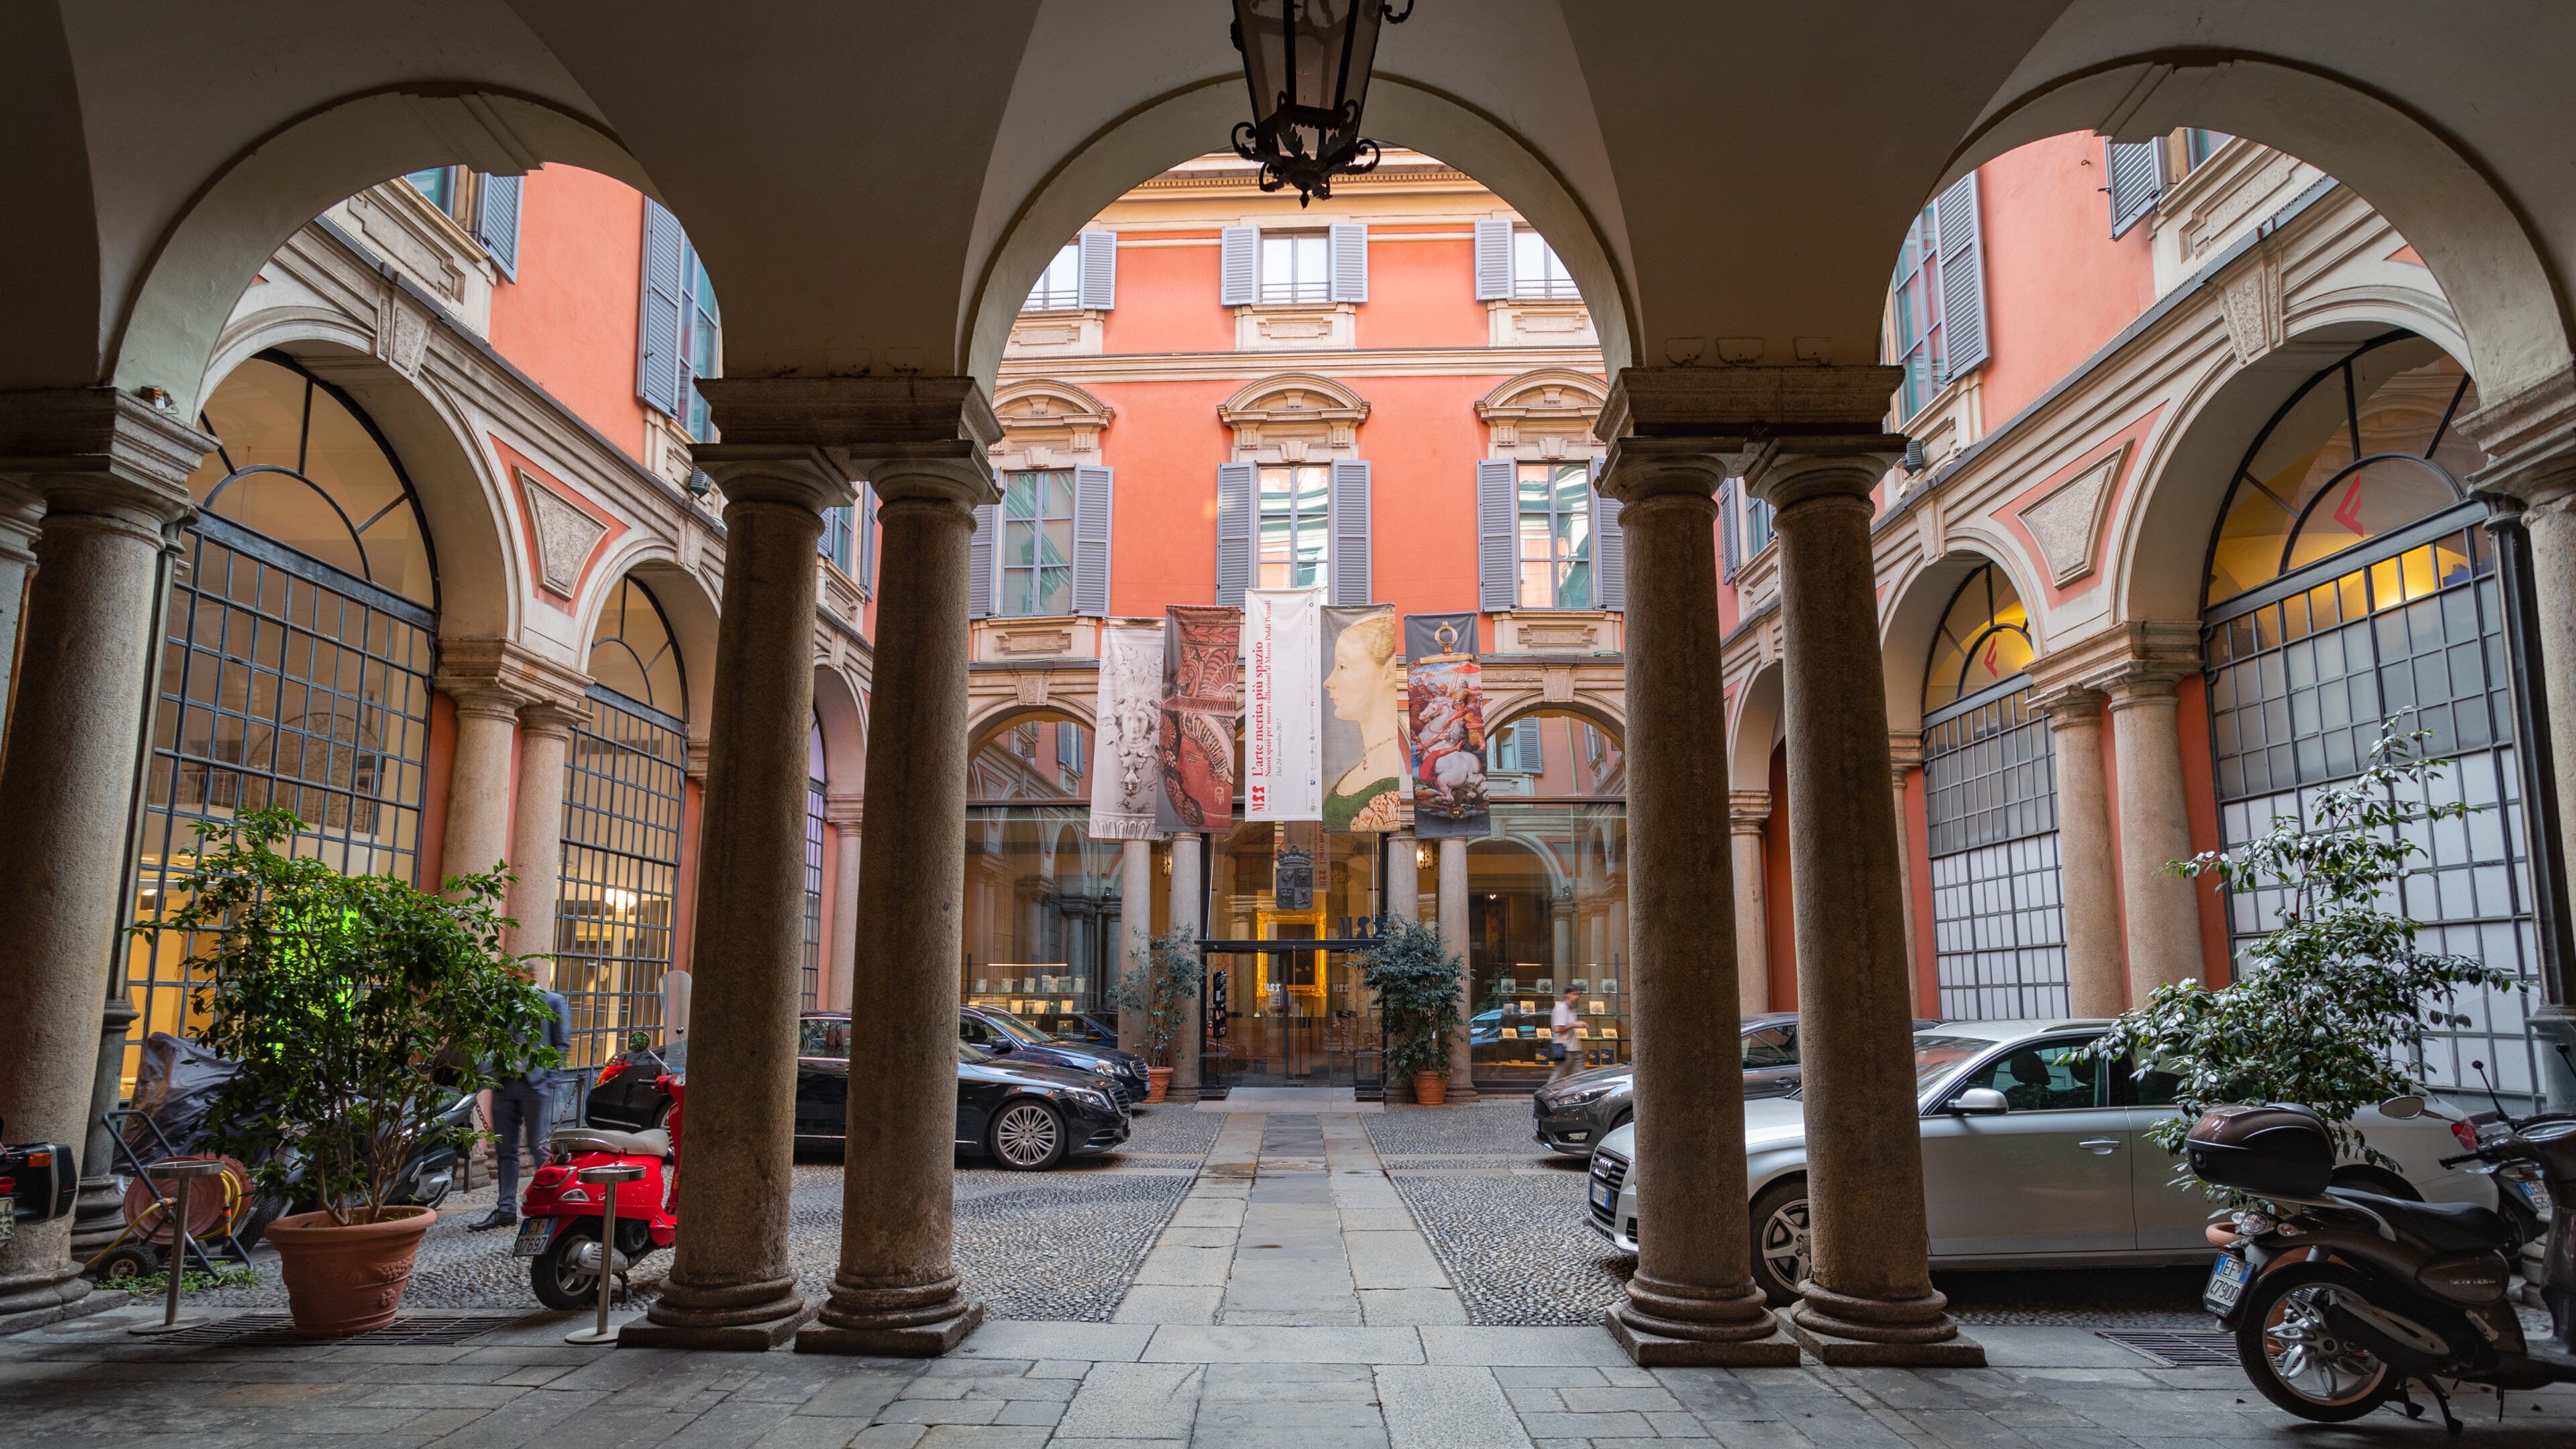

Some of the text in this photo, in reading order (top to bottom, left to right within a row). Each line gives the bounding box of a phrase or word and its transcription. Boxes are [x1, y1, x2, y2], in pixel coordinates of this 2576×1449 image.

[1252, 641, 1267, 678] spazio
[1252, 681, 1267, 701] più
[1252, 704, 1264, 741] merita
[1277, 757, 1283, 766] 24
[528, 1220, 543, 1233] CY
[516, 1236, 547, 1252] 07697
[2223, 1259, 2239, 1276] EF
[2209, 1279, 2240, 1302] 47900
